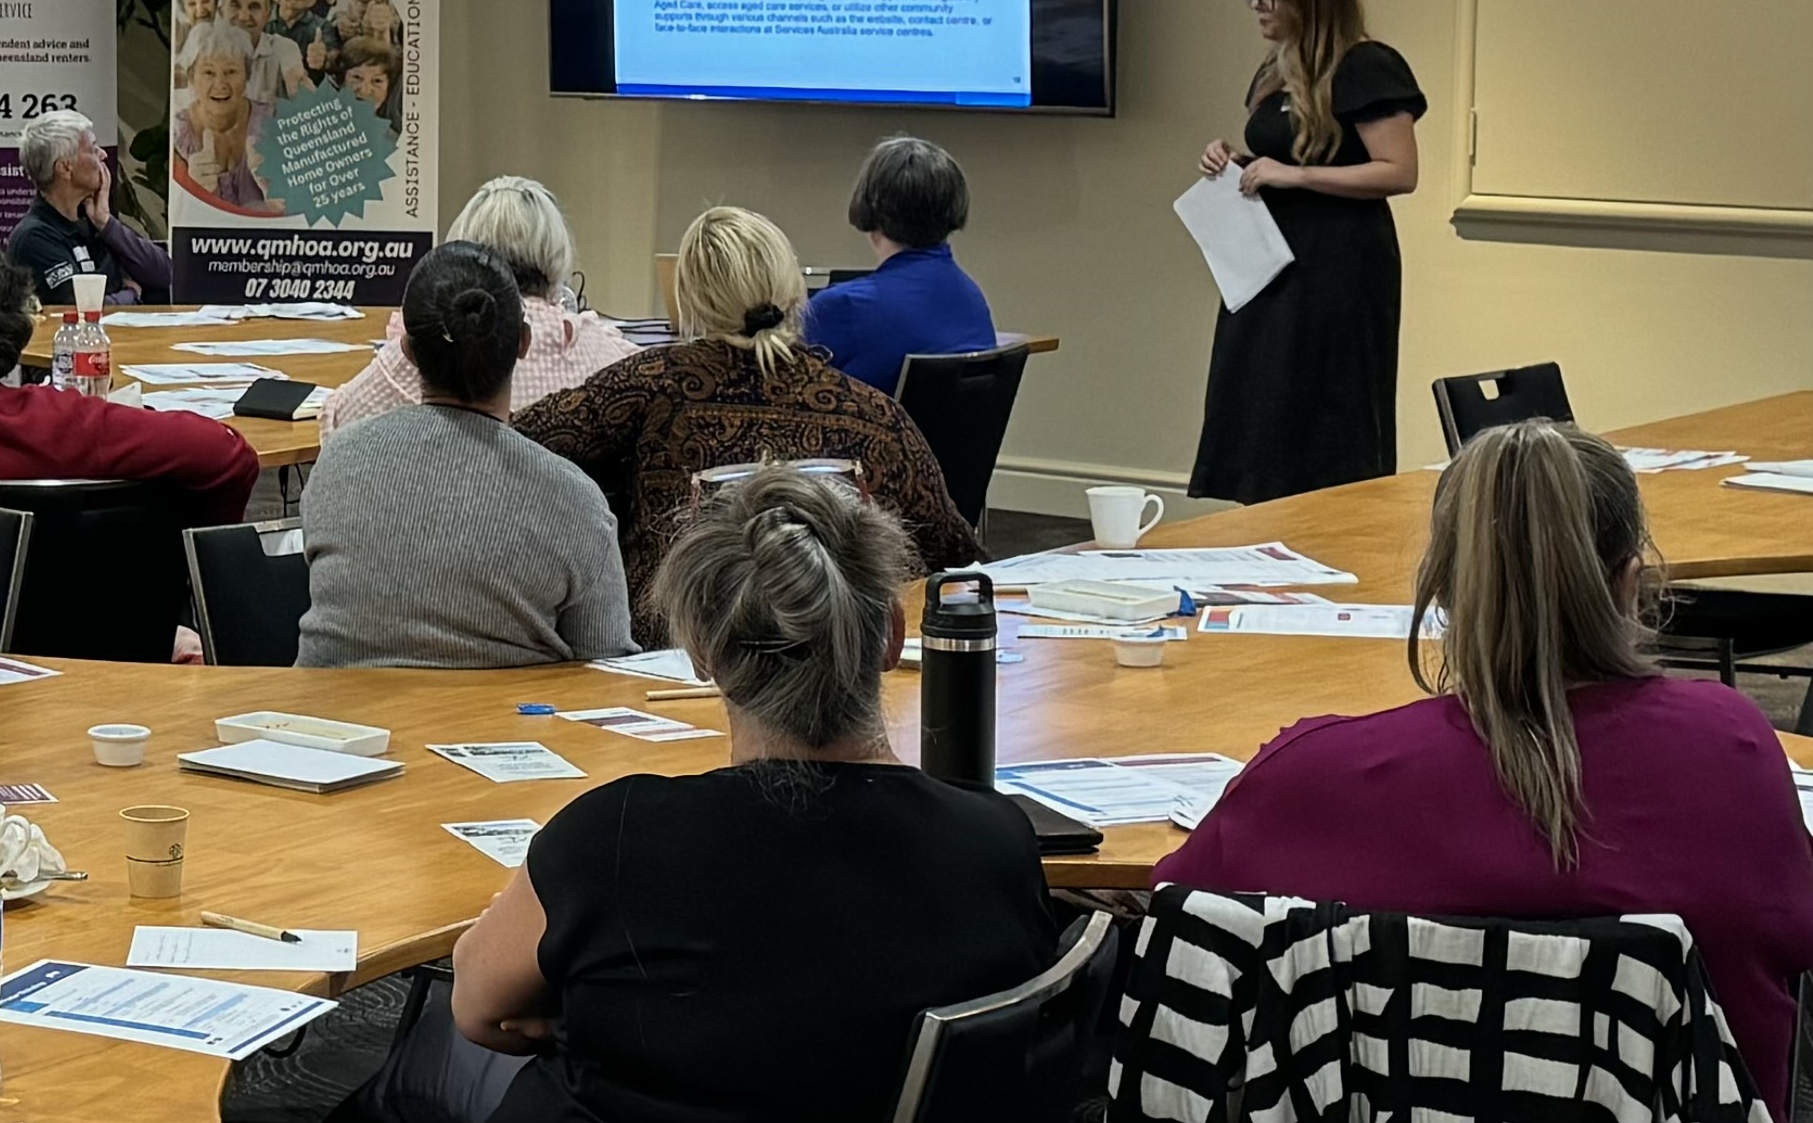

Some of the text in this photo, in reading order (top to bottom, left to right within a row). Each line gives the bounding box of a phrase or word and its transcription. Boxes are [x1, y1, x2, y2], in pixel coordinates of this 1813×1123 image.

[654, 0, 678, 11] Aged
[707, 2, 738, 10] access
[741, 1, 764, 12] aged
[766, 3, 786, 11] care
[874, 3, 898, 12] other
[901, 3, 954, 15] community
[695, 12, 729, 23] through
[732, 13, 764, 23] various
[767, 13, 808, 23] channels
[811, 13, 833, 24] such
[849, 14, 864, 23] the
[908, 15, 944, 25] contact
[33, 38, 67, 49] advice
[70, 38, 90, 49] and
[775, 24, 814, 35] Services
[817, 26, 857, 36] Australia
[860, 27, 894, 36] service
[21, 93, 78, 120] 263
[277, 98, 342, 130] Protecting
[277, 105, 353, 145] the Rights of
[281, 131, 368, 175] Manufactured
[283, 121, 356, 159] Queensland
[287, 148, 373, 188] Home Owners
[405, 110, 420, 218] ASSISTANCE
[309, 168, 360, 195] for Over
[313, 181, 366, 208] 25 years
[191, 233, 414, 263] www.qmhoa.org.au
[208, 258, 396, 279] membership@qmhoa.org.au
[245, 278, 356, 300] 07 3040 2344
